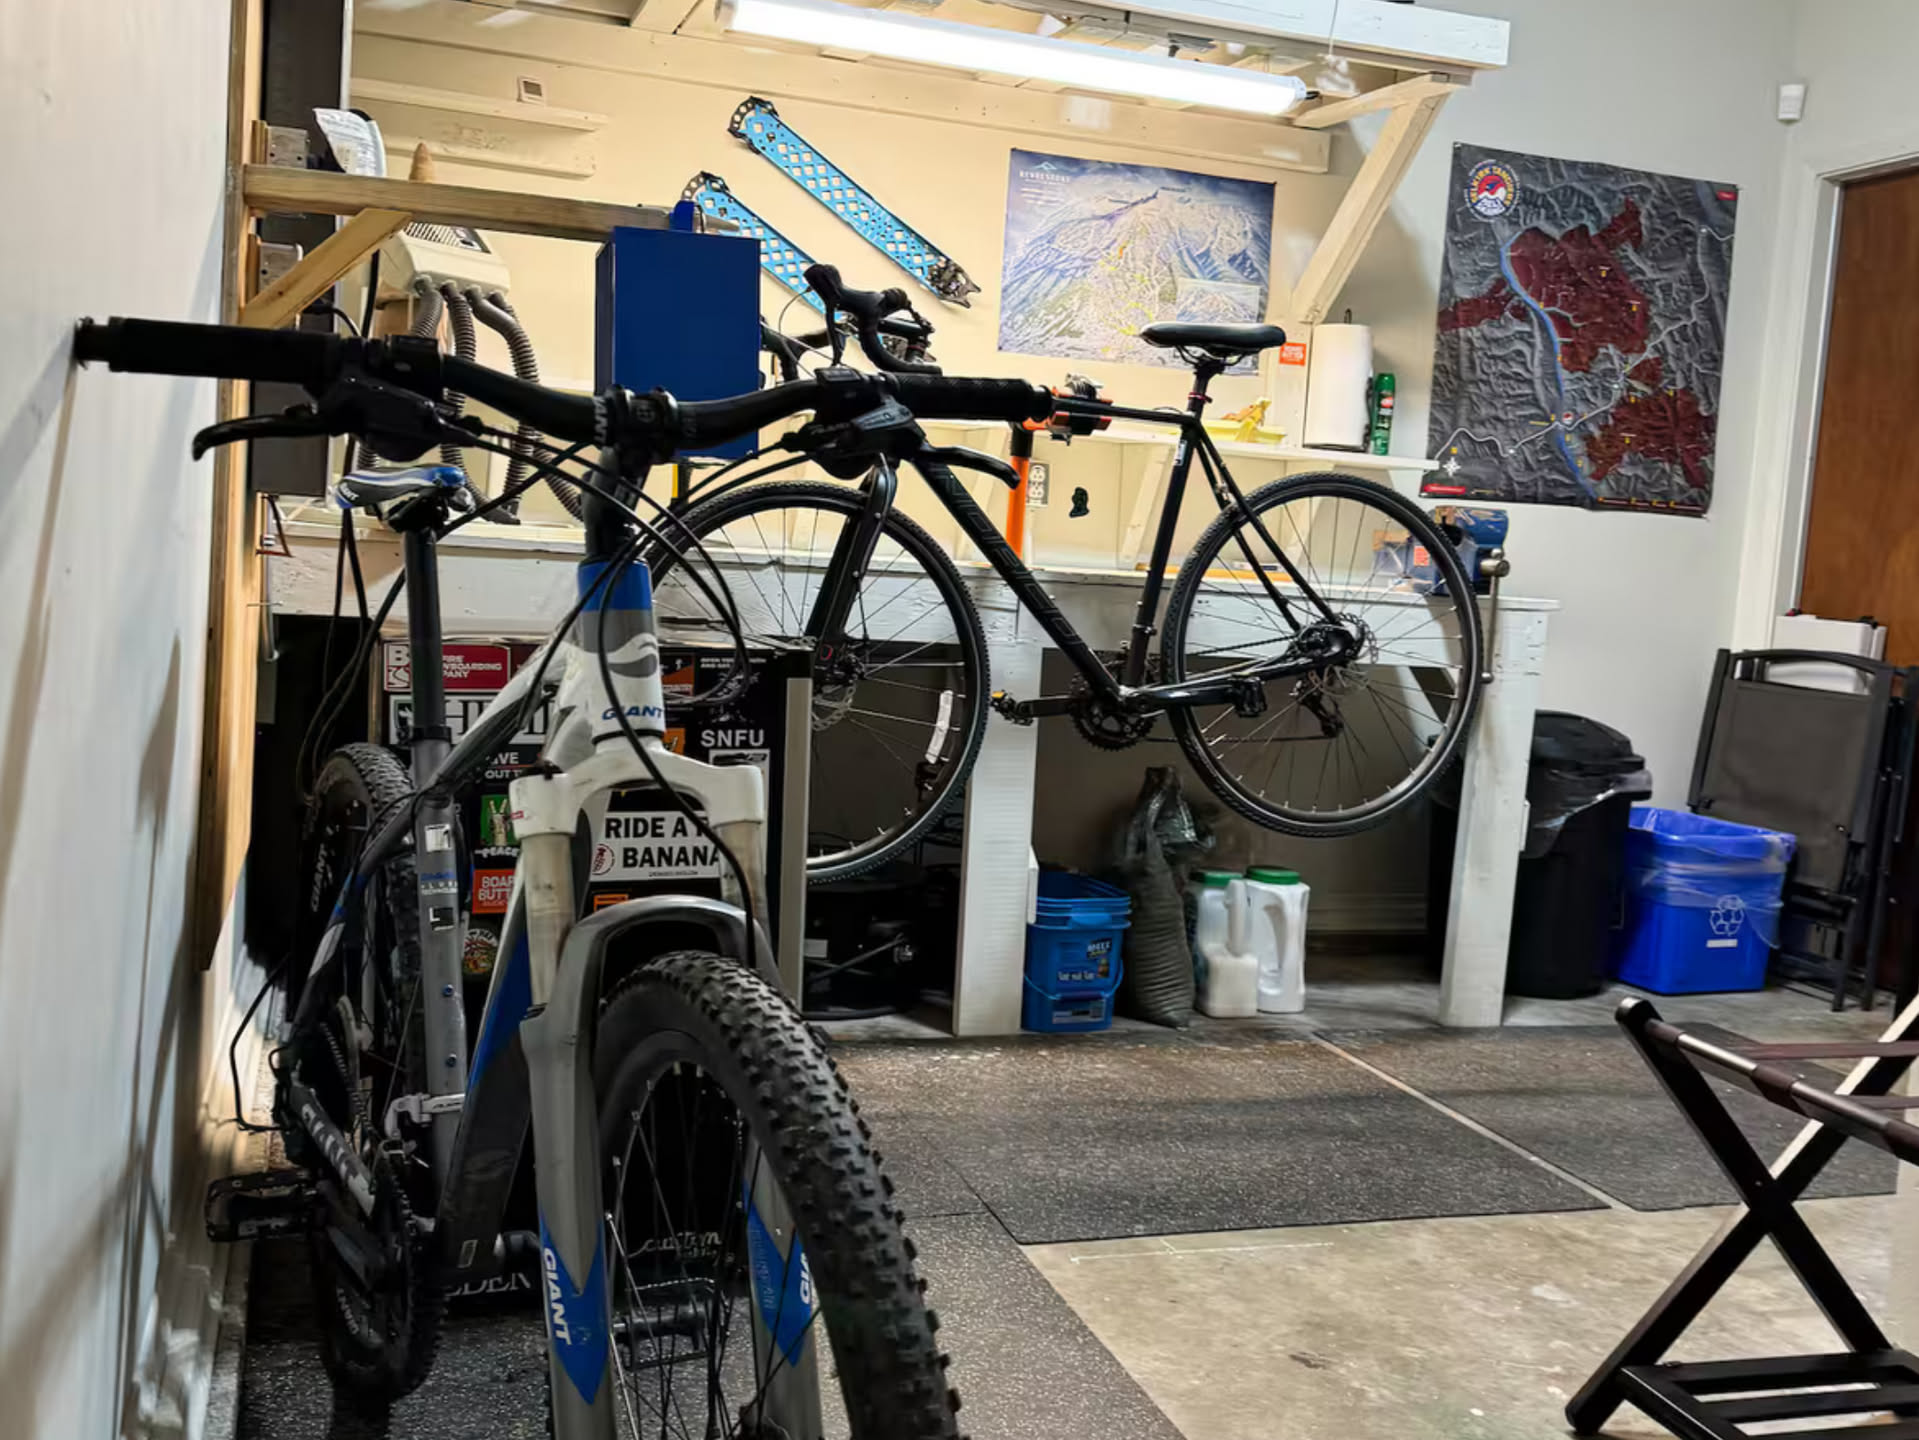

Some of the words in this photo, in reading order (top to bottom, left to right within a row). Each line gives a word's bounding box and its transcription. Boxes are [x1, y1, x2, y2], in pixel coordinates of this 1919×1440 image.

[700, 728, 765, 748] SNFU
[605, 817, 665, 839] RIDE
[672, 816, 689, 838] A
[542, 1247, 572, 1346] GIANT
